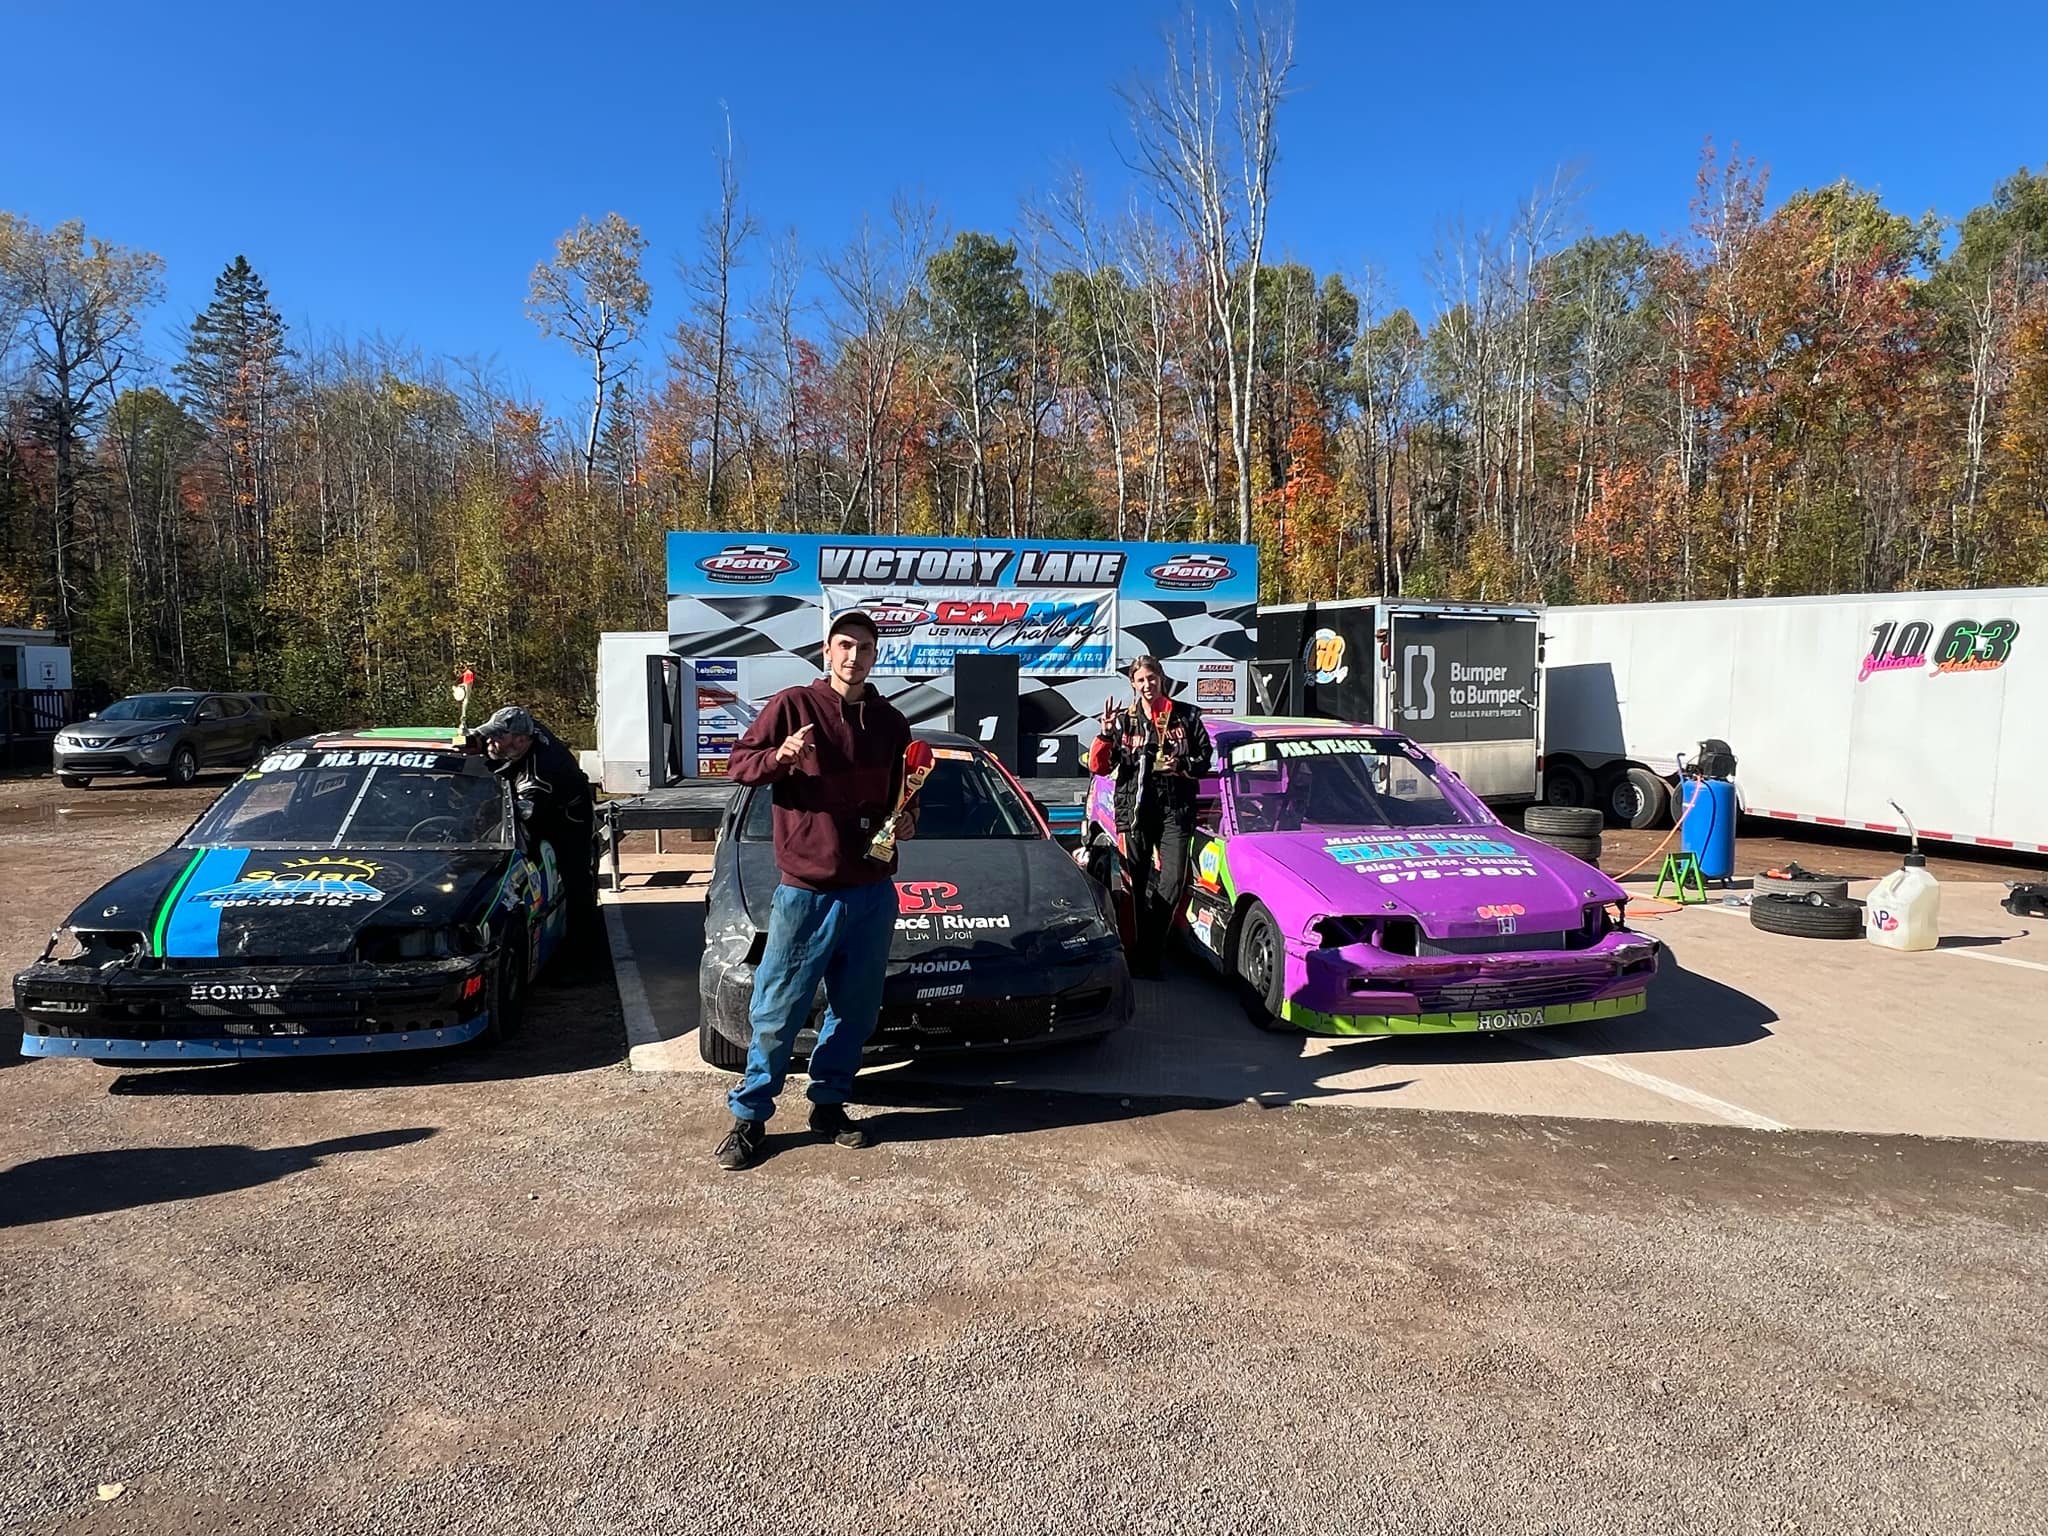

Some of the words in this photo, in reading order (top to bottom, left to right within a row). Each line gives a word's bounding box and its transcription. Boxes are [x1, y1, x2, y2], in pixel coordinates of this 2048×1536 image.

[716, 557, 781, 571] Petty
[820, 548, 1014, 585] VICTORY
[1015, 551, 1126, 586] LANE
[1162, 564, 1221, 579] Petty
[864, 609, 920, 623] etty
[928, 628, 950, 636] US
[954, 628, 992, 636] INEX
[987, 616, 1110, 650] Challenge
[1871, 620, 1934, 662] 10
[1932, 620, 2021, 664] 63
[877, 644, 910, 665] 024
[917, 648, 954, 657] LEGEND
[1450, 662, 1508, 686] Bumper
[1449, 686, 1466, 704] to
[1467, 685, 1523, 708] Bumper
[978, 715, 999, 741] 1
[1036, 738, 1060, 764] 2
[258, 752, 308, 773] 60
[1324, 835, 1404, 846] Maritime
[1407, 833, 1445, 842] Mini
[1326, 842, 1423, 863] HEAT
[1423, 840, 1517, 857] PUMP
[1466, 856, 1534, 867] Cleaning
[309, 891, 386, 902] PROS
[894, 914, 931, 930] acé
[942, 914, 1011, 929] Rivard
[1872, 910, 1890, 930] VP
[909, 960, 972, 975] HONDA
[190, 984, 280, 1000] HONDA
[1478, 1010, 1545, 1030] HONDA
